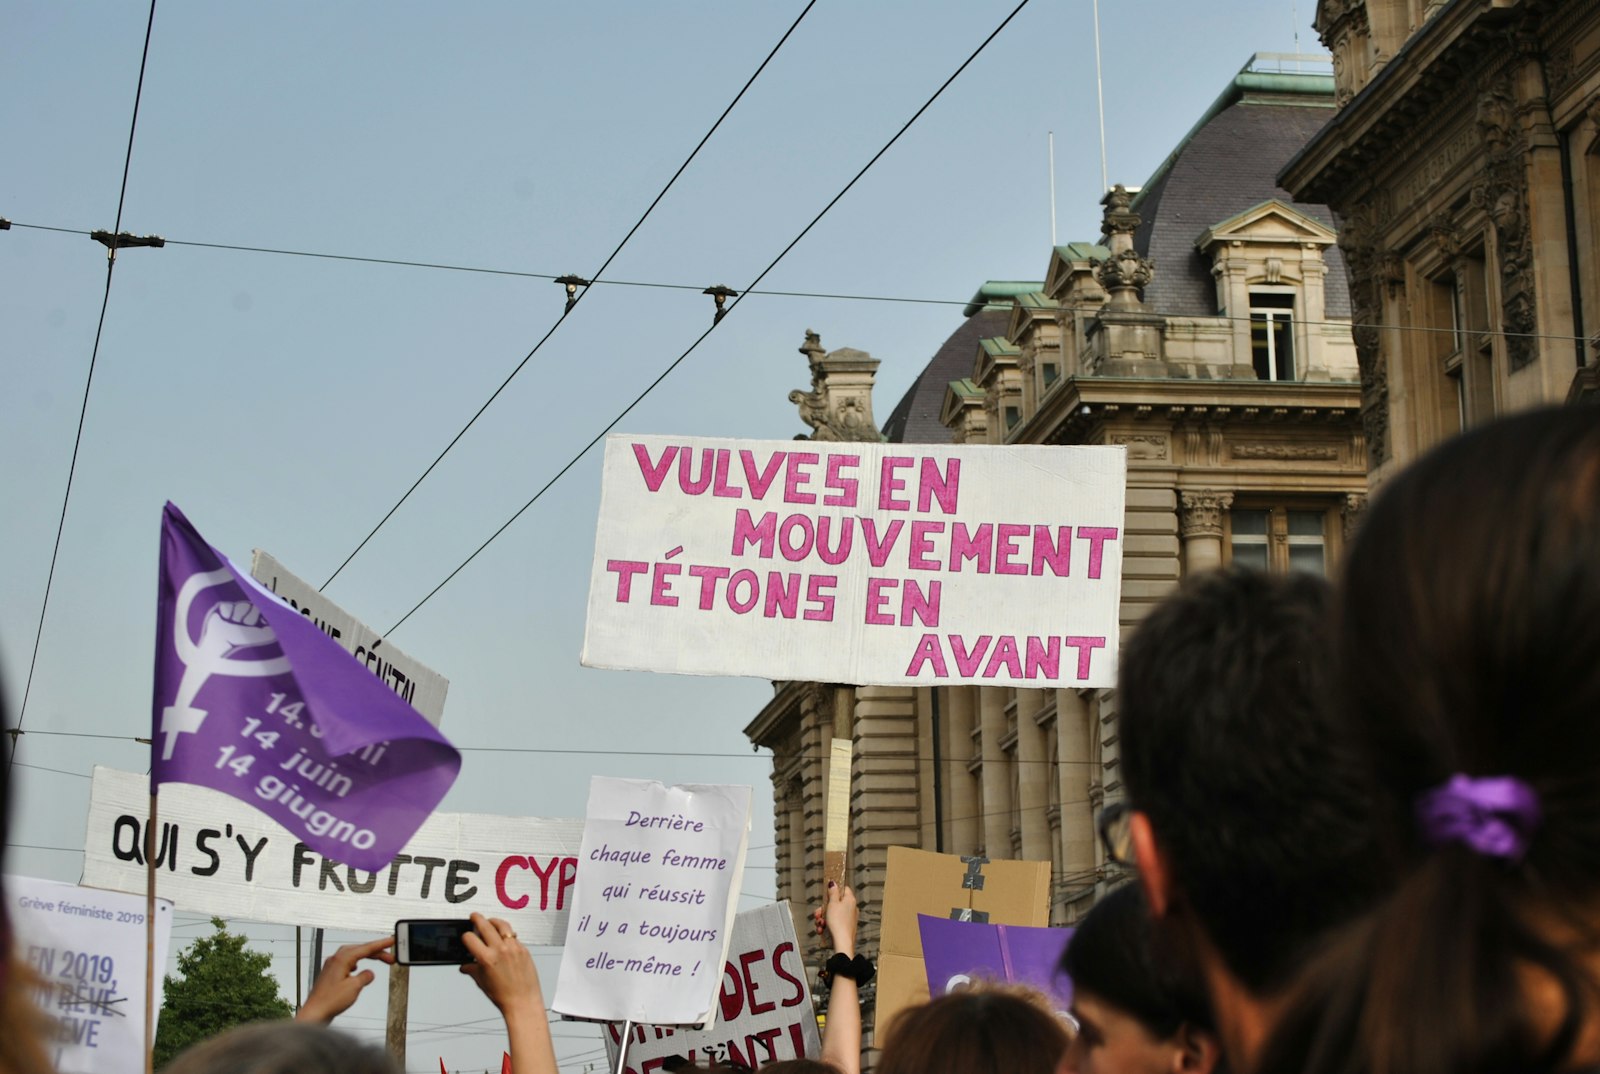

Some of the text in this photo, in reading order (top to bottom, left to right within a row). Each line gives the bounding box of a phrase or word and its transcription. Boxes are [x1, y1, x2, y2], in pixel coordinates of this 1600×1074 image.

[631, 443, 961, 514] VULVES EN
[731, 508, 1118, 579] MOUVEMENT
[607, 546, 941, 627] TÉTONS EN
[905, 634, 1106, 680] AVANT
[265, 692, 304, 729] 14.
[240, 716, 353, 798] 14 juin
[215, 745, 377, 851] 14 giugno
[625, 811, 704, 833] Derrière
[112, 815, 180, 872] QUI
[191, 823, 268, 882] S'Y
[589, 844, 727, 871] chaque femme
[19, 896, 145, 924] Grève féministe 2019
[602, 883, 706, 905] qui réussit
[577, 915, 717, 944] il y a toujours
[60, 950, 117, 992] 2019,
[585, 952, 683, 977] elle-même
